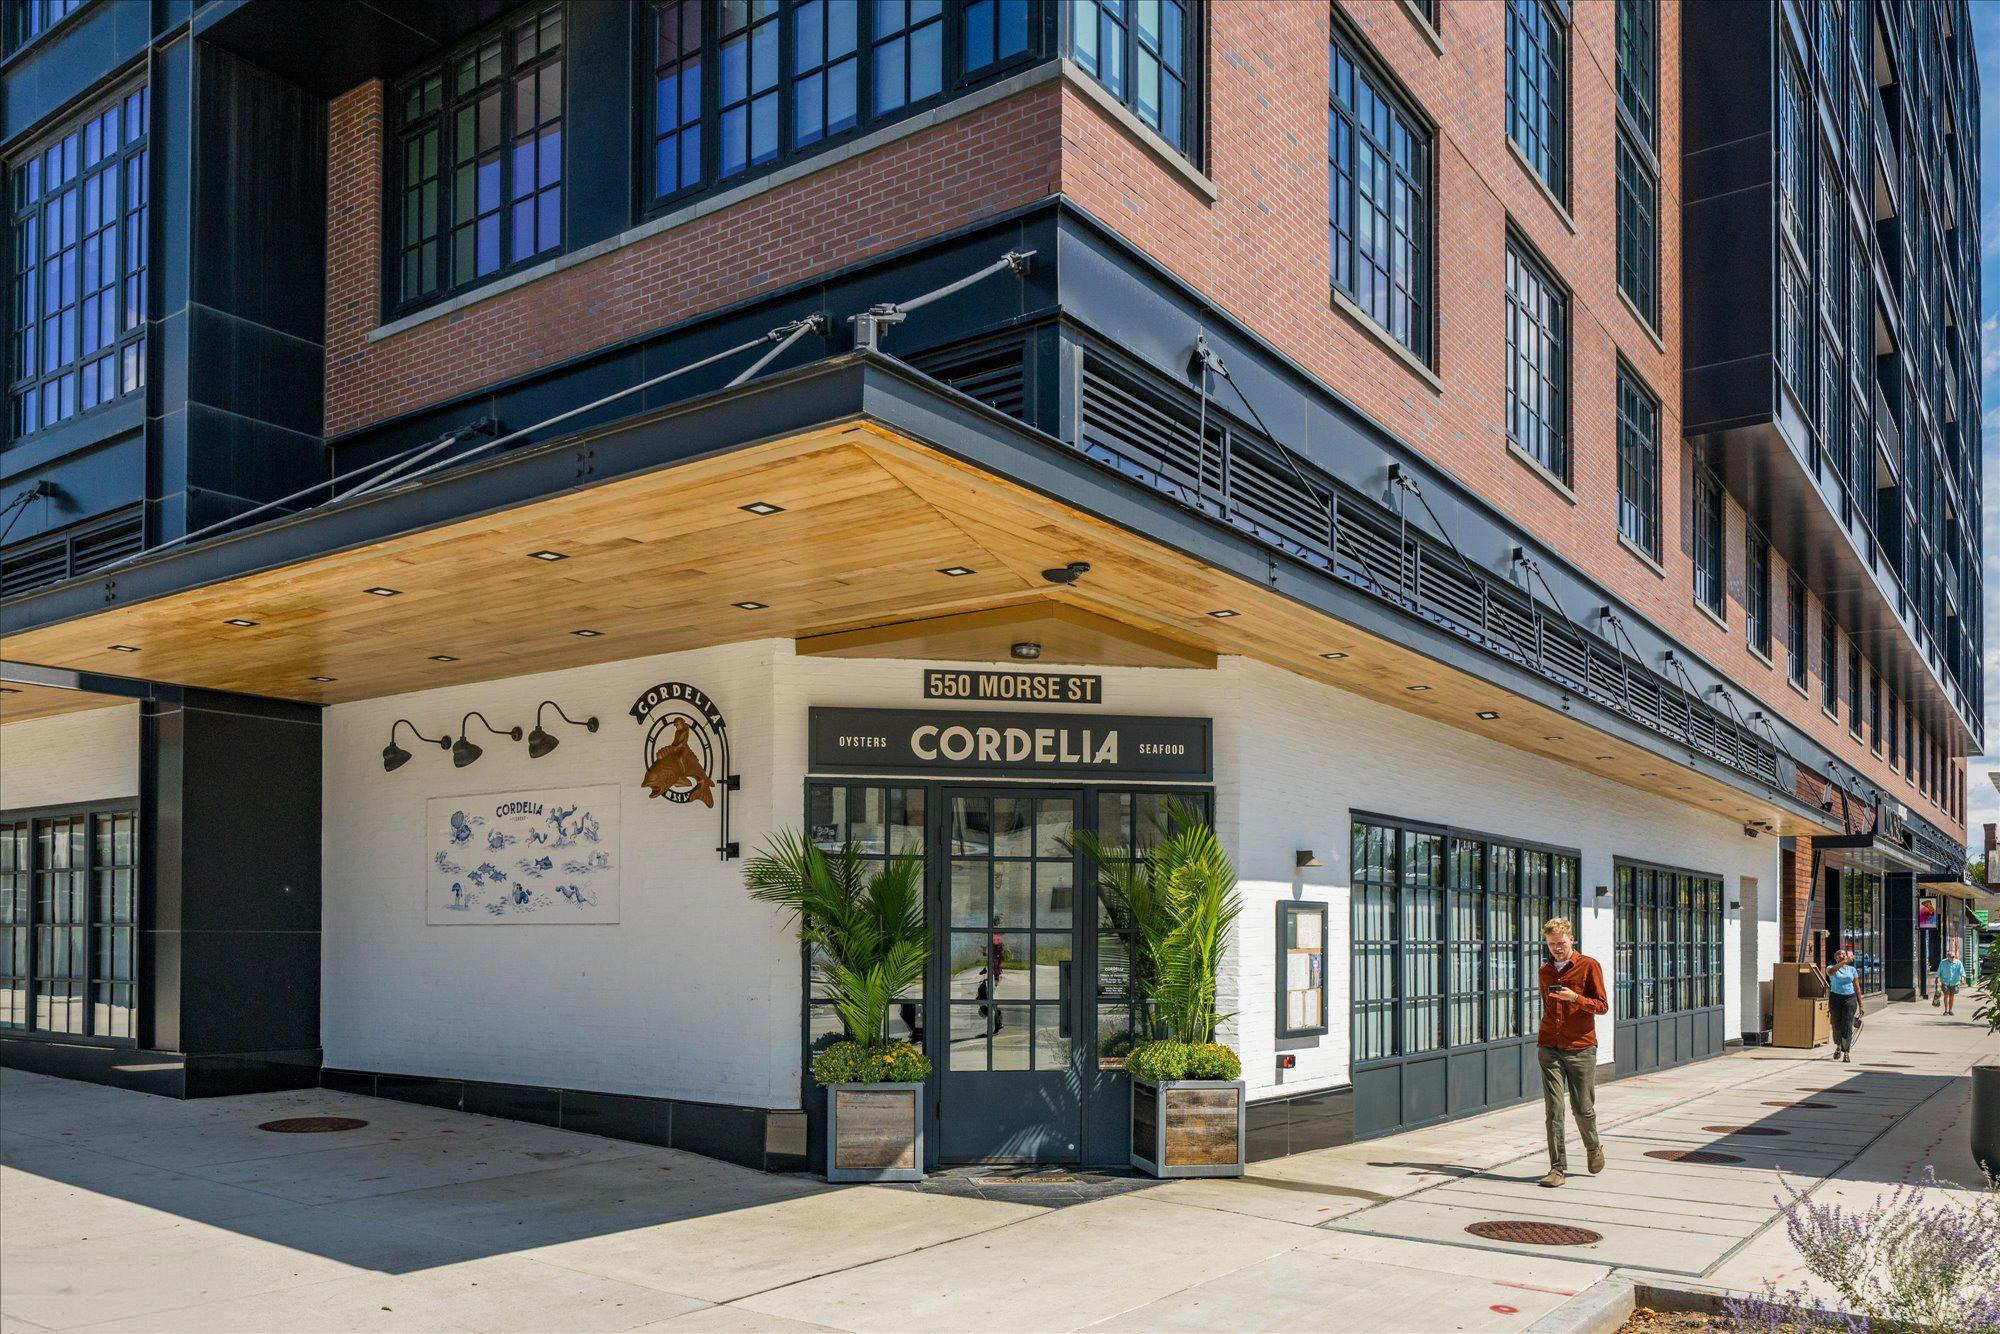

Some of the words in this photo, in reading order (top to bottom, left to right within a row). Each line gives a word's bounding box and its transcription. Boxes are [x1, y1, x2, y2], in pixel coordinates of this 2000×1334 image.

[930, 673, 971, 697] 550
[979, 675, 1061, 699] MORSE
[1067, 677, 1096, 700] ST
[638, 684, 721, 725] CORDELIA
[839, 736, 887, 748] OYSTERS
[910, 725, 1119, 764] CORDELIA
[1139, 743, 1185, 755] SEAFOOD
[495, 801, 543, 818] CORDELIA
